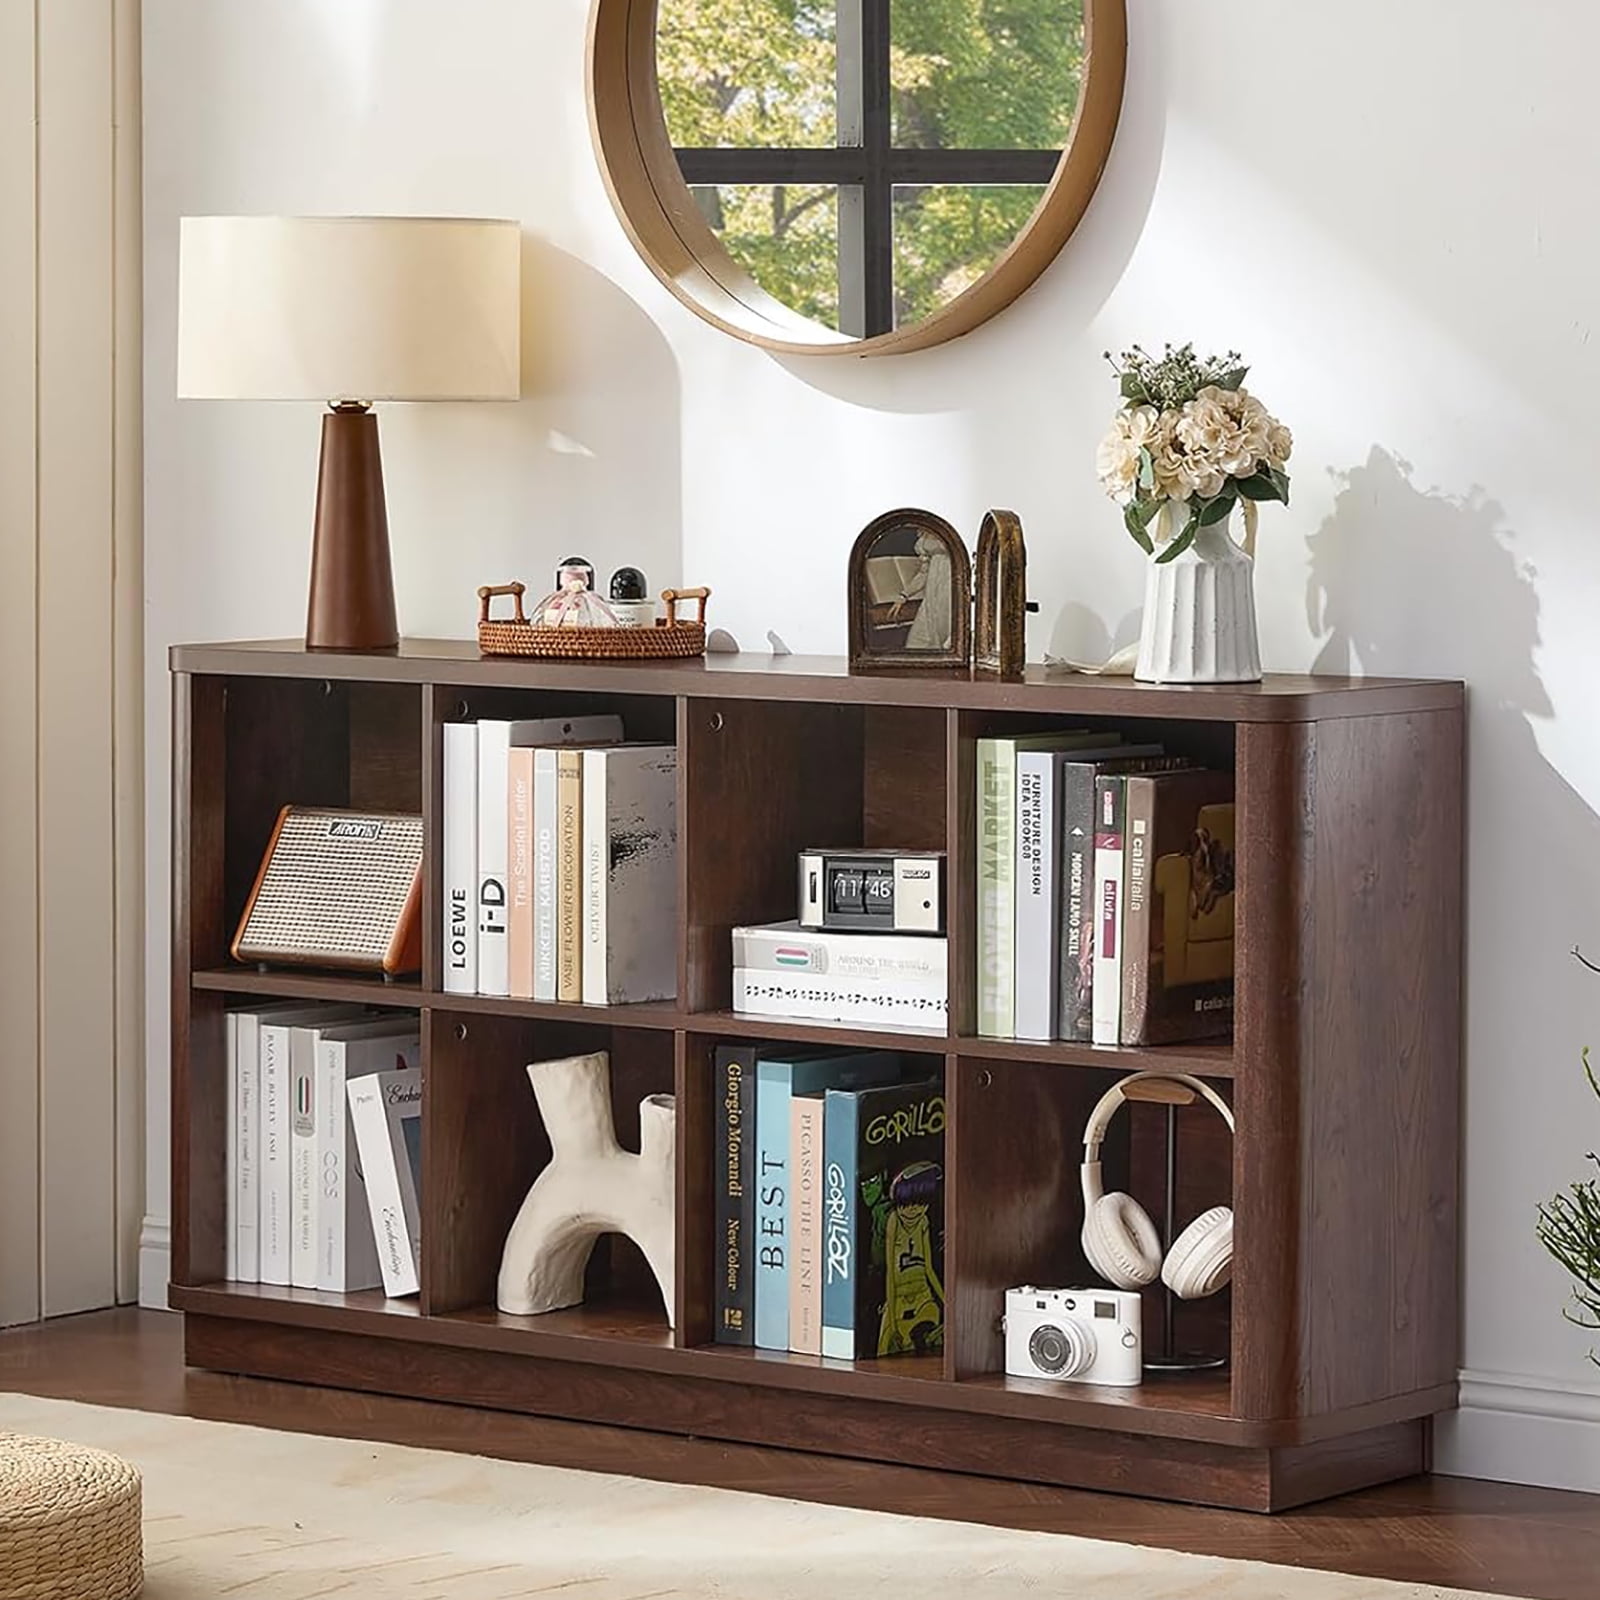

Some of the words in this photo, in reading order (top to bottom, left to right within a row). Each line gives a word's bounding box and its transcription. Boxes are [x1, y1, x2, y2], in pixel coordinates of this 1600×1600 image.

[515, 778, 527, 821] Letter
[1022, 773, 1030, 802] IDEA
[983, 760, 1009, 881] MARKET
[564, 804, 573, 892] DECORATION
[516, 882, 527, 907] The
[870, 880, 890, 898] 46
[1070, 852, 1082, 896] MODERN
[452, 889, 466, 968] LOEWE
[481, 878, 505, 933] i-D
[564, 895, 573, 952] FLOWER
[1068, 927, 1079, 957] SKILL
[564, 955, 573, 989] VASE
[727, 1063, 742, 1125] Giorgio
[324, 1151, 337, 1199] COS
[727, 1127, 742, 1197] Morandi
[802, 1114, 811, 1192] PICASSO
[728, 1219, 740, 1247] New
[761, 1150, 785, 1270] BEST
[802, 1197, 811, 1238] THE
[728, 1247, 741, 1291] Colour
[802, 1247, 811, 1294] LINE
